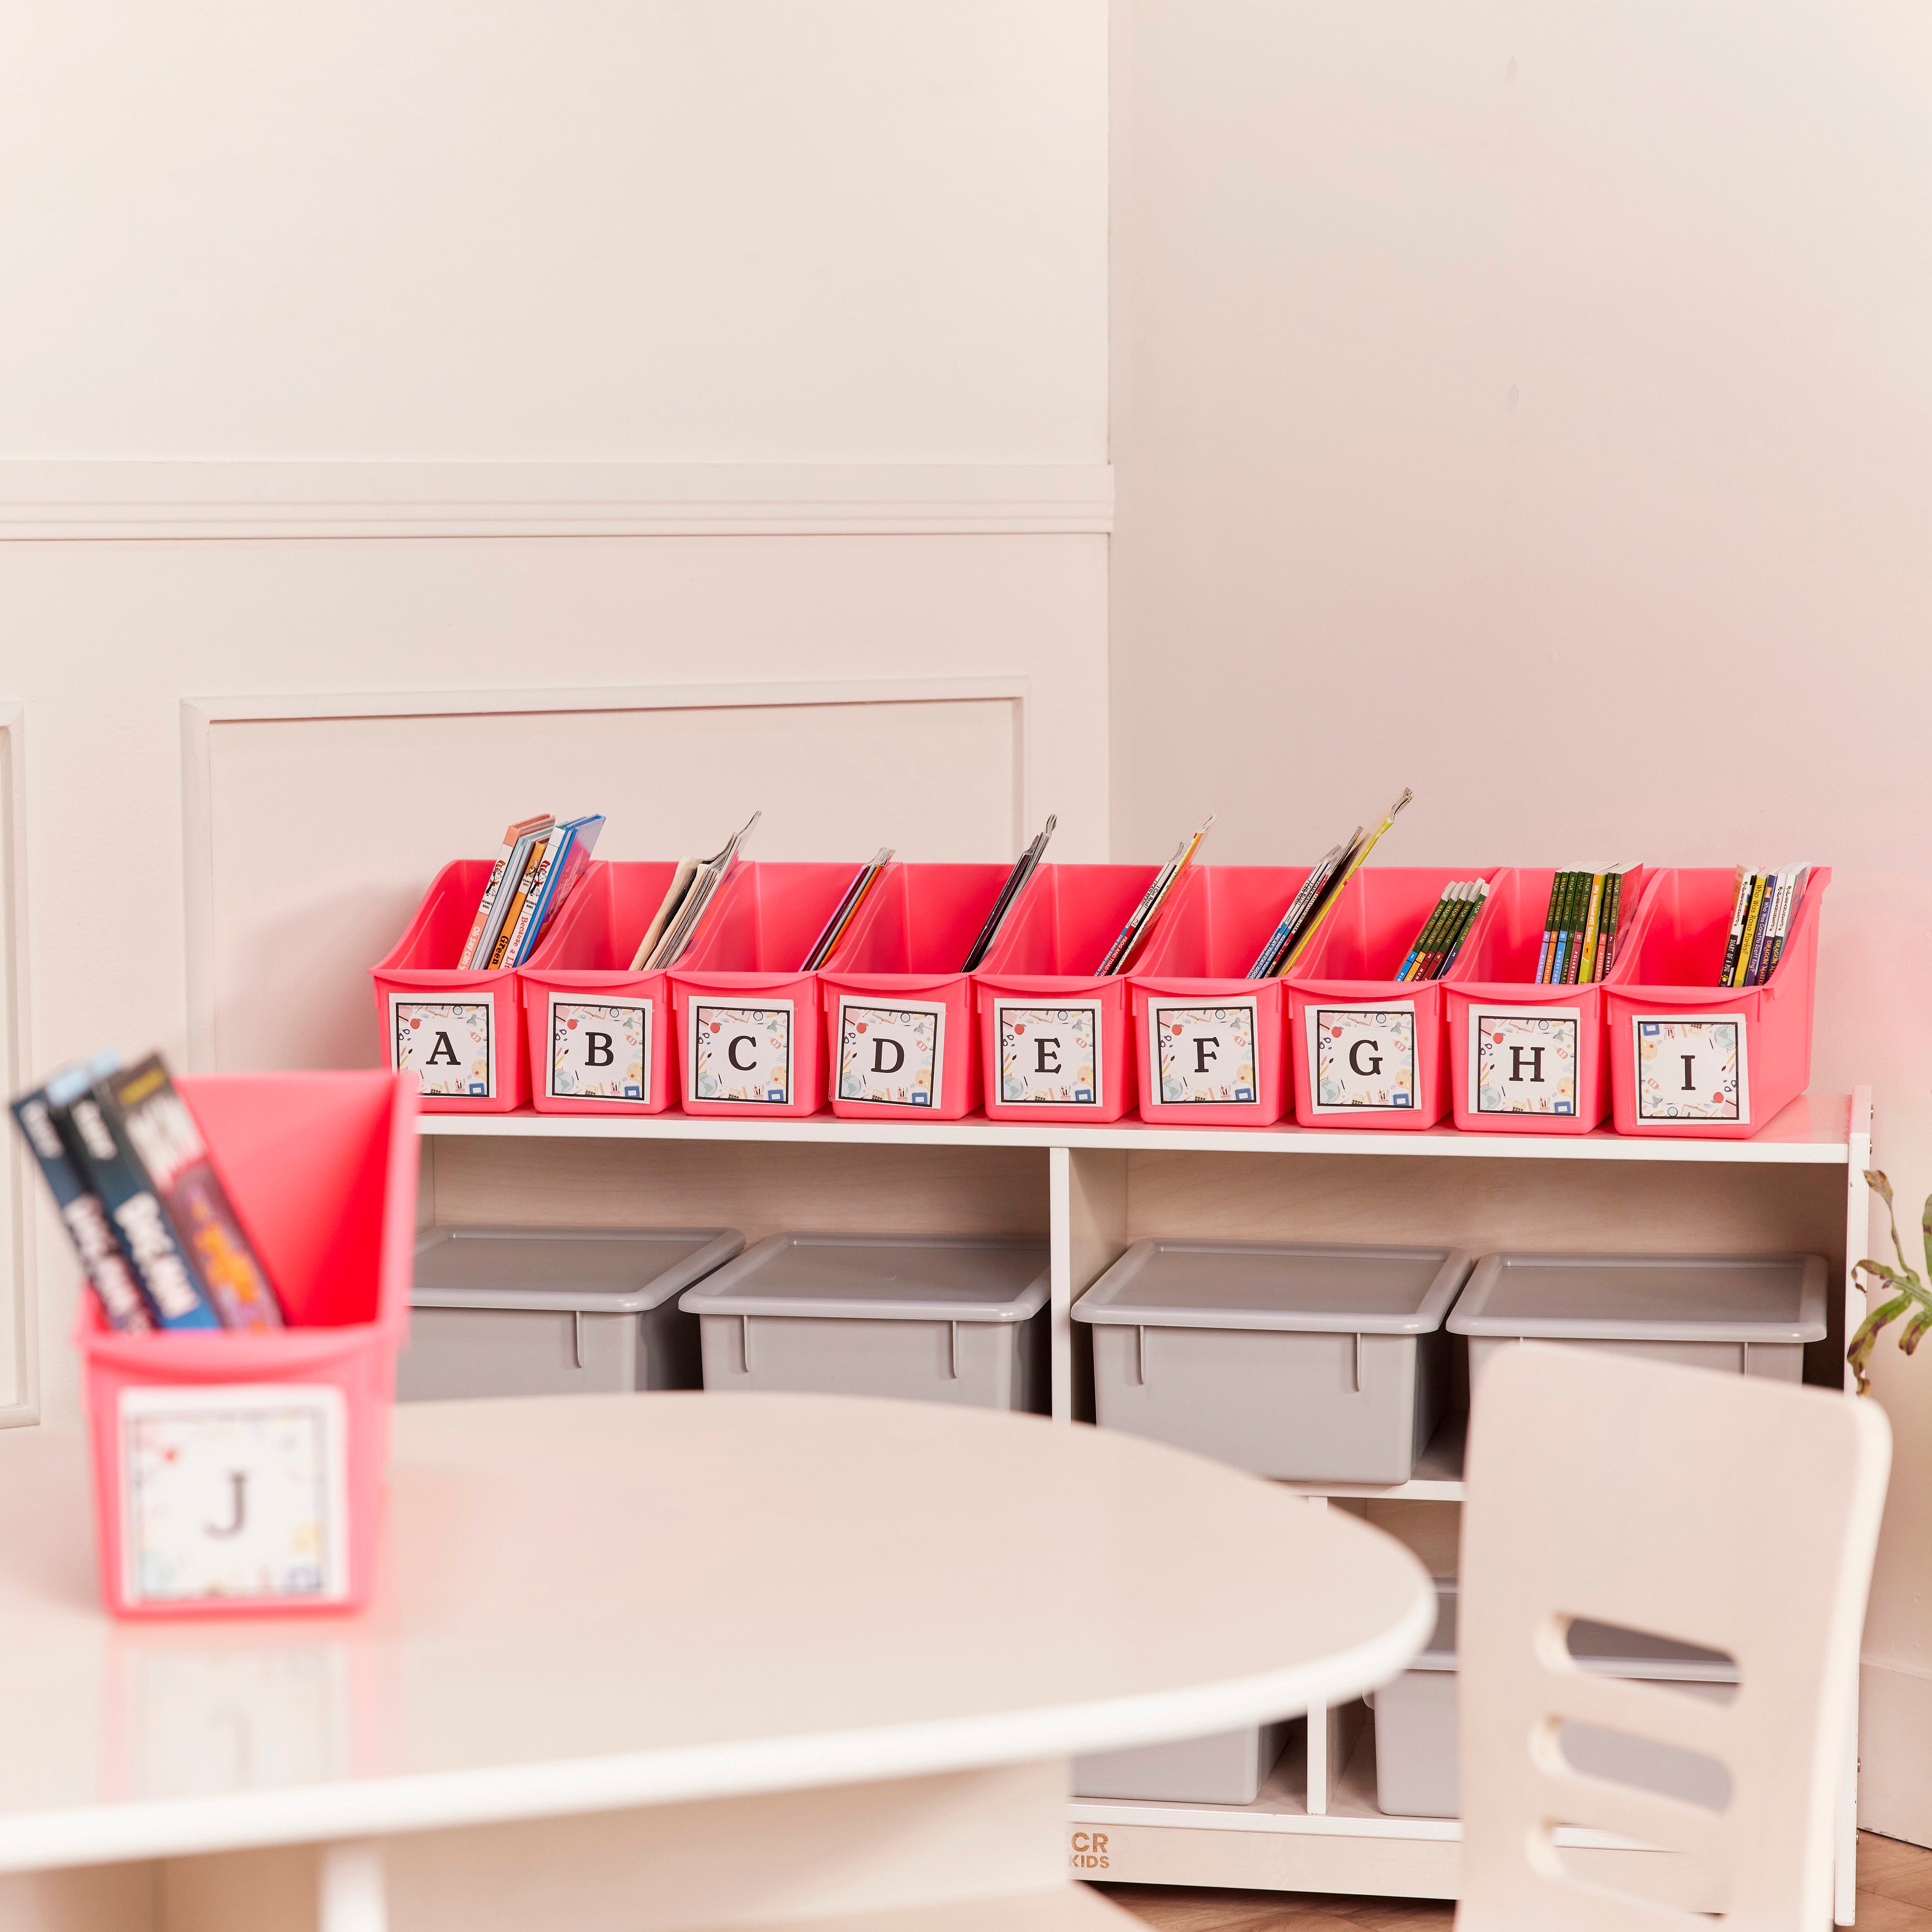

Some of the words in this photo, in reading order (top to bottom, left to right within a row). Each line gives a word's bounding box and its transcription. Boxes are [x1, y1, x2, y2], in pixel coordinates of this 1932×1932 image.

[1593, 885, 1599, 894] My
[1754, 883, 1762, 898] Who
[1143, 895, 1153, 909] Read!
[1472, 899, 1483, 915] MAGIC
[1433, 904, 1443, 919] MAGIC
[1441, 904, 1451, 919] MAGIC
[1449, 904, 1461, 918] MAGIC
[1459, 904, 1469, 919] MAGIC
[1426, 918, 1435, 930] TREE
[1435, 918, 1443, 930] TREE
[1444, 918, 1452, 928] TREE
[1453, 919, 1461, 929] TREE
[1467, 915, 1475, 926] TREE
[1747, 914, 1756, 931] Rosa
[471, 925, 481, 938] Oh
[511, 915, 529, 947] Because
[1419, 929, 1429, 944] HOUSE
[1427, 930, 1437, 945] HOUSE
[1435, 929, 1446, 944] HOUSE
[1445, 930, 1455, 945] HOUSE
[1459, 926, 1469, 942] HOUSE
[465, 936, 476, 951] say
[1118, 936, 1127, 949] FROG
[1270, 932, 1281, 947] SPLAT
[1728, 939, 1736, 952] DIARY
[1742, 933, 1752, 954] Parks?
[461, 950, 472, 965] can
[490, 935, 510, 966] Green
[1111, 947, 1120, 958] AND
[1761, 939, 1773, 965] DRAGON
[1770, 938, 1782, 965] DRAGON
[1104, 957, 1114, 970] TOAD
[1257, 955, 1266, 966] CAT:
[1748, 958, 1757, 972] King?
[426, 1032, 461, 1065] A
[585, 1032, 613, 1066] B
[728, 1036, 756, 1070] C
[871, 1038, 904, 1073] D
[1035, 1038, 1061, 1074] E
[1193, 1037, 1219, 1072] F
[1350, 1040, 1383, 1076] G
[1509, 1046, 1545, 1082] H
[1681, 1055, 1695, 1090] I
[204, 1469, 250, 1542] J
[1068, 1854, 1110, 1868] KIDS
